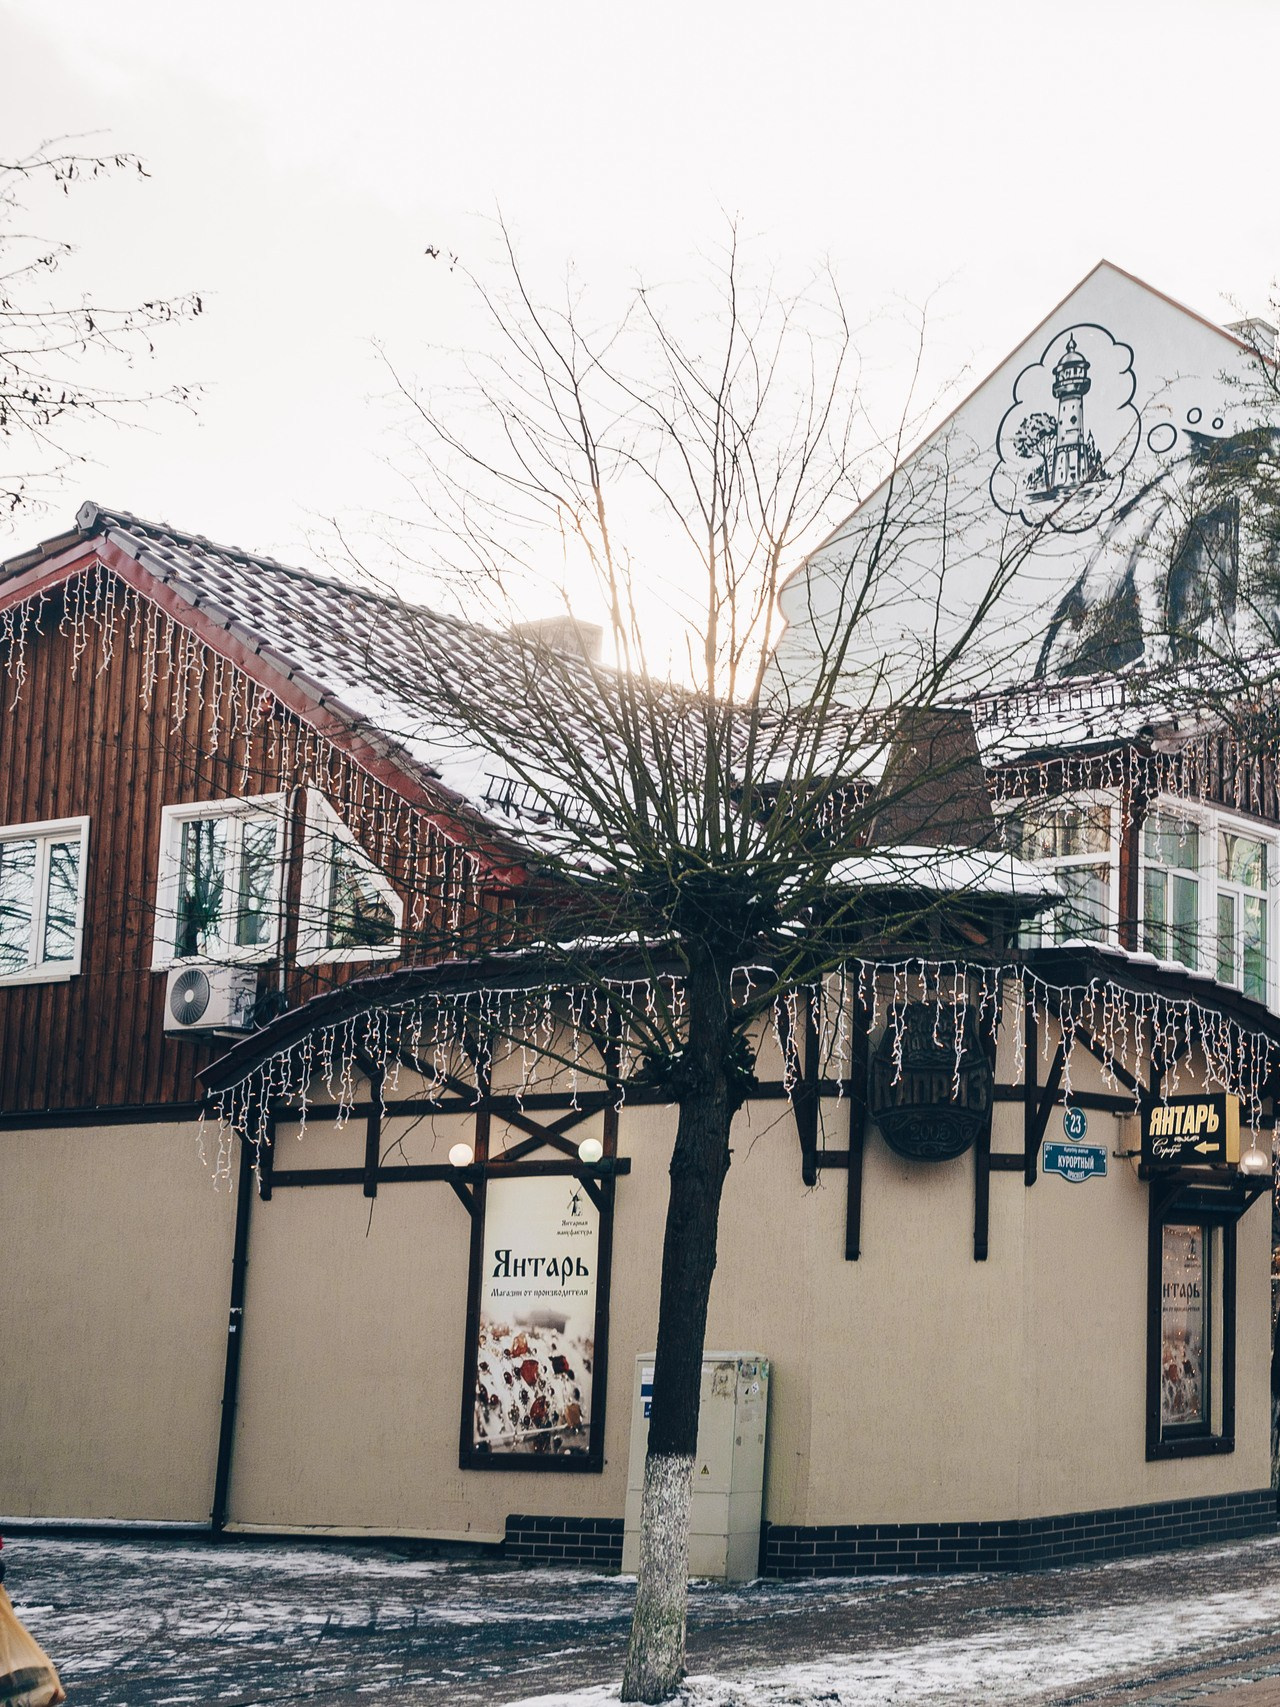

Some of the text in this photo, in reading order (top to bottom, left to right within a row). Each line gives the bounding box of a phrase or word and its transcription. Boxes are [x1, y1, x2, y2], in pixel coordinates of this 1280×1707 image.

[1070, 1115, 1081, 1134] 23
[1149, 1104, 1219, 1136] ЯНТАРЬ
[1057, 1155, 1095, 1169] КУРОРТНЫЙ
[492, 1249, 589, 1286] Янтарь
[490, 1288, 522, 1297] Магазин
[534, 1289, 589, 1298] производителя
[1163, 1282, 1200, 1304] нтарь
